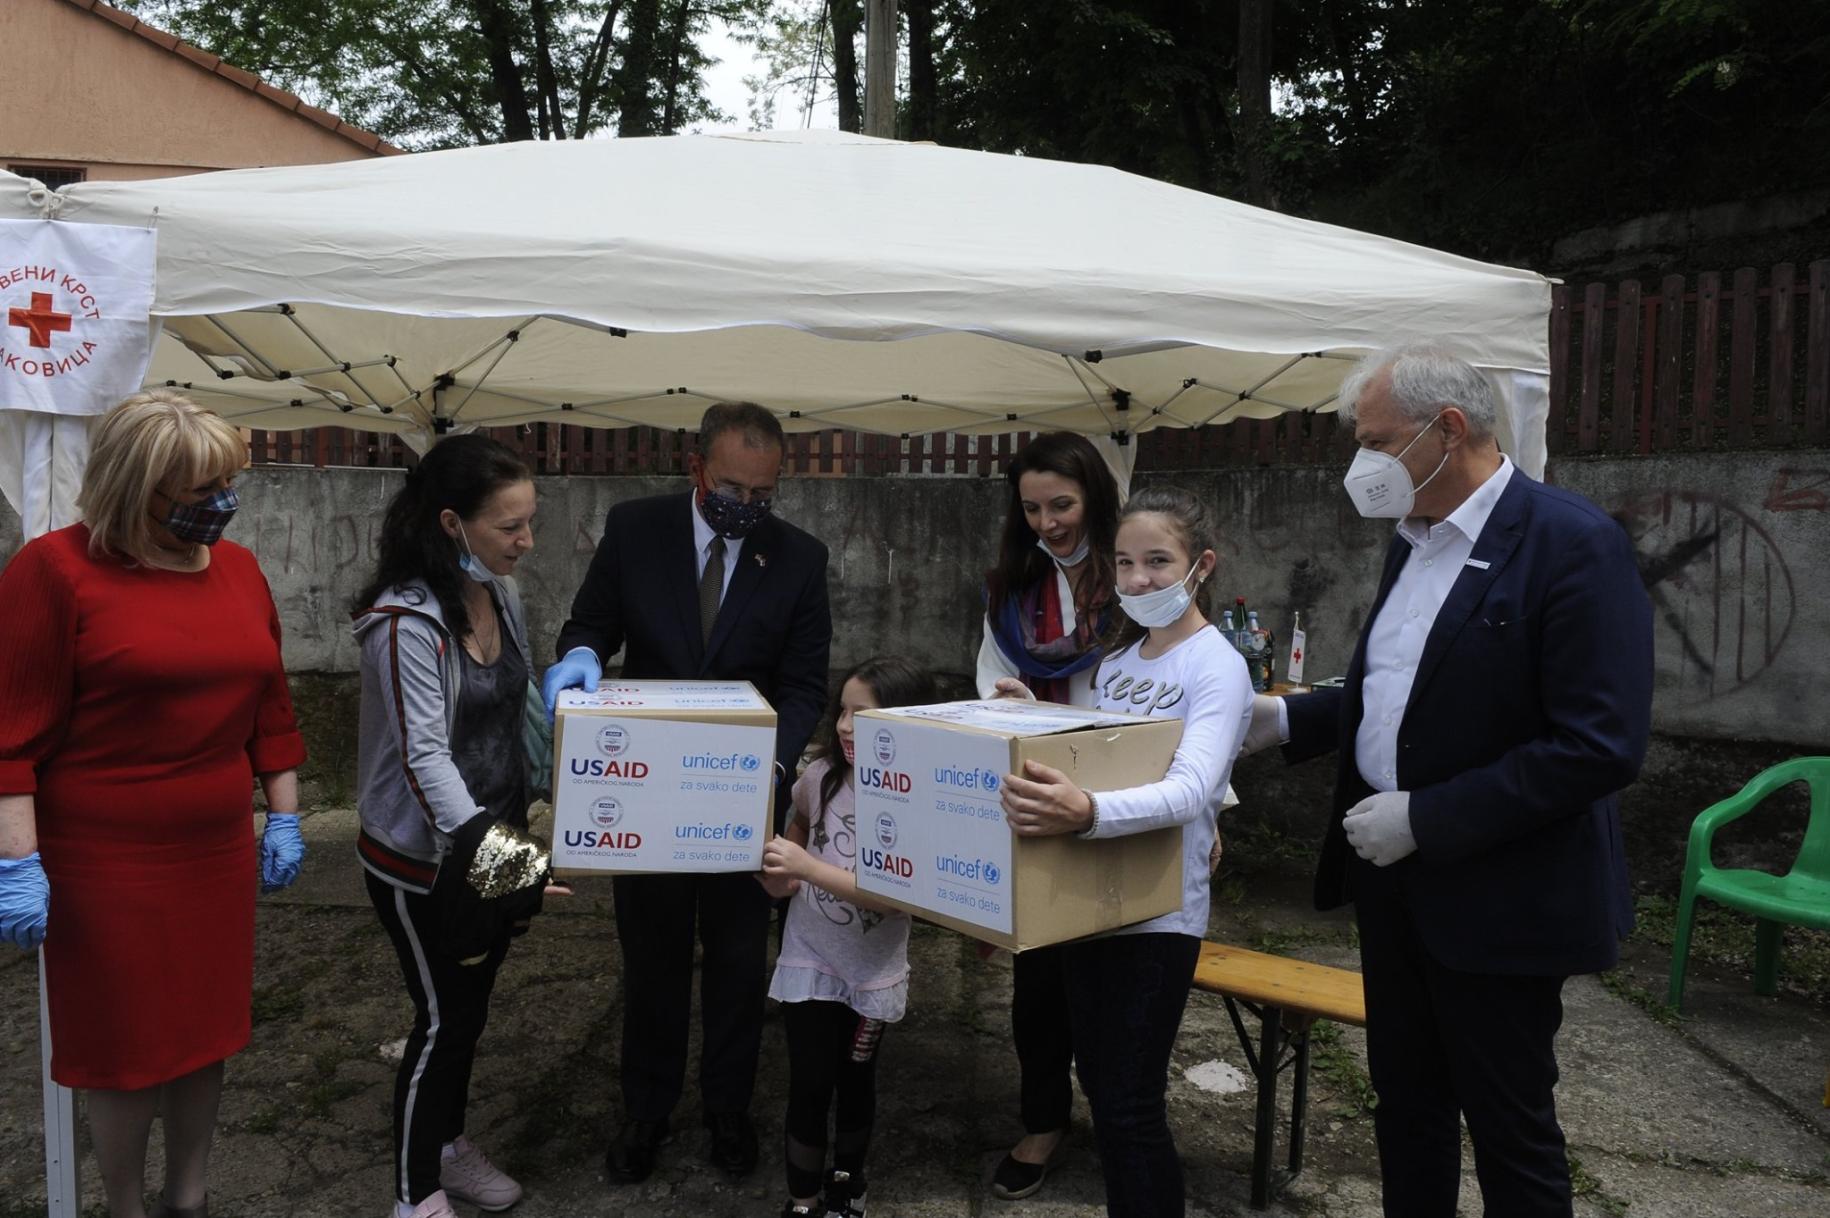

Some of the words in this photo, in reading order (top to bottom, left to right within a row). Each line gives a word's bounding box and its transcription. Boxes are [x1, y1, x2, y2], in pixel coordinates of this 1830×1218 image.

[60, 274, 100, 319] КРСТ
[571, 758, 649, 778] USAID
[682, 752, 738, 770] unicef
[680, 781, 693, 790] za
[696, 781, 729, 792] svako
[732, 782, 757, 793] dete
[860, 766, 911, 793] USAID
[935, 764, 979, 789] unicef
[936, 800, 946, 811] za
[949, 801, 975, 816] svako
[977, 805, 1000, 822] dete
[564, 830, 642, 849] USAID
[675, 822, 731, 839] unicef
[673, 851, 686, 860] za
[689, 850, 722, 861] svako
[724, 851, 750, 862] dete
[862, 847, 913, 878] USAID
[936, 854, 981, 880] unicef
[937, 887, 947, 899] za
[949, 890, 976, 907] svako
[978, 896, 1000, 914] dete
